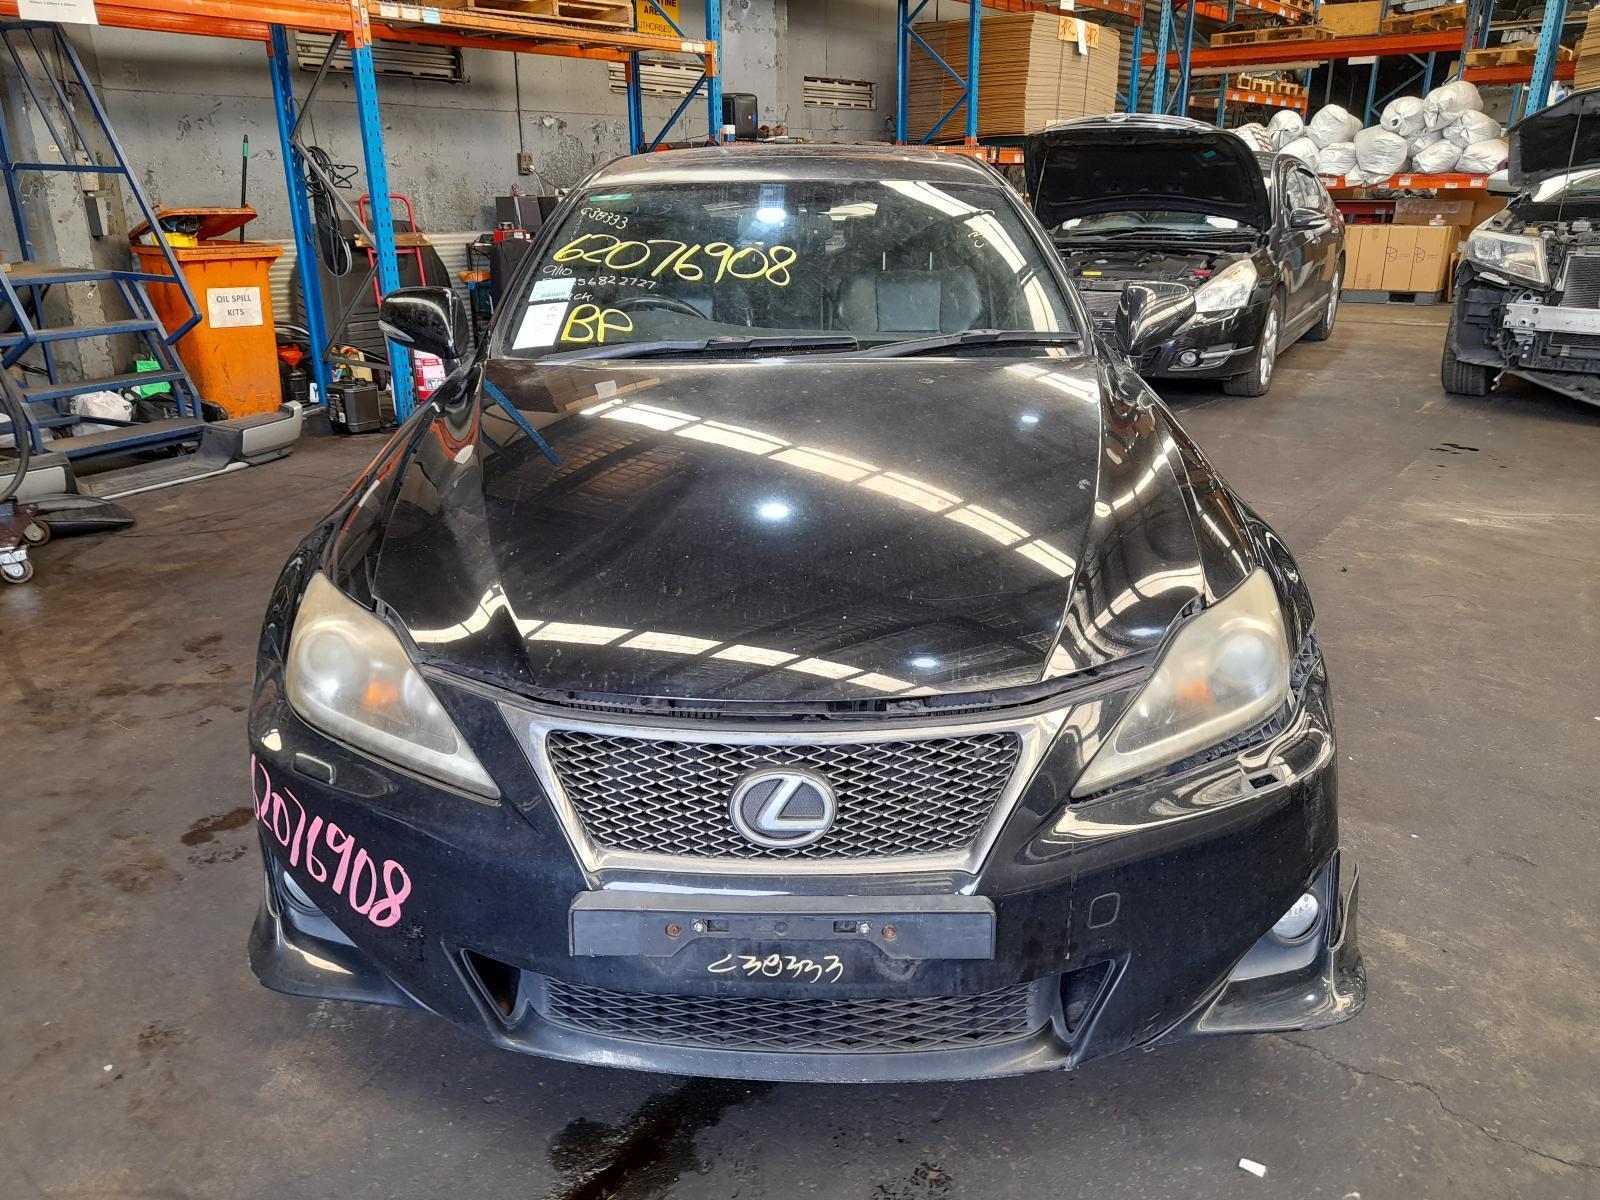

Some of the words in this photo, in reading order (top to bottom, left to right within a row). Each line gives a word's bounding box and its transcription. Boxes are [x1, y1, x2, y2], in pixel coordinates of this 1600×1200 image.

[644, 6, 662, 16] ARE
[638, 21, 672, 33] UTHORISED
[552, 233, 797, 286] 62076908
[216, 295, 230, 303] OIL
[231, 294, 252, 303] SPILL
[227, 308, 245, 317] KITS
[560, 303, 633, 343] BP
